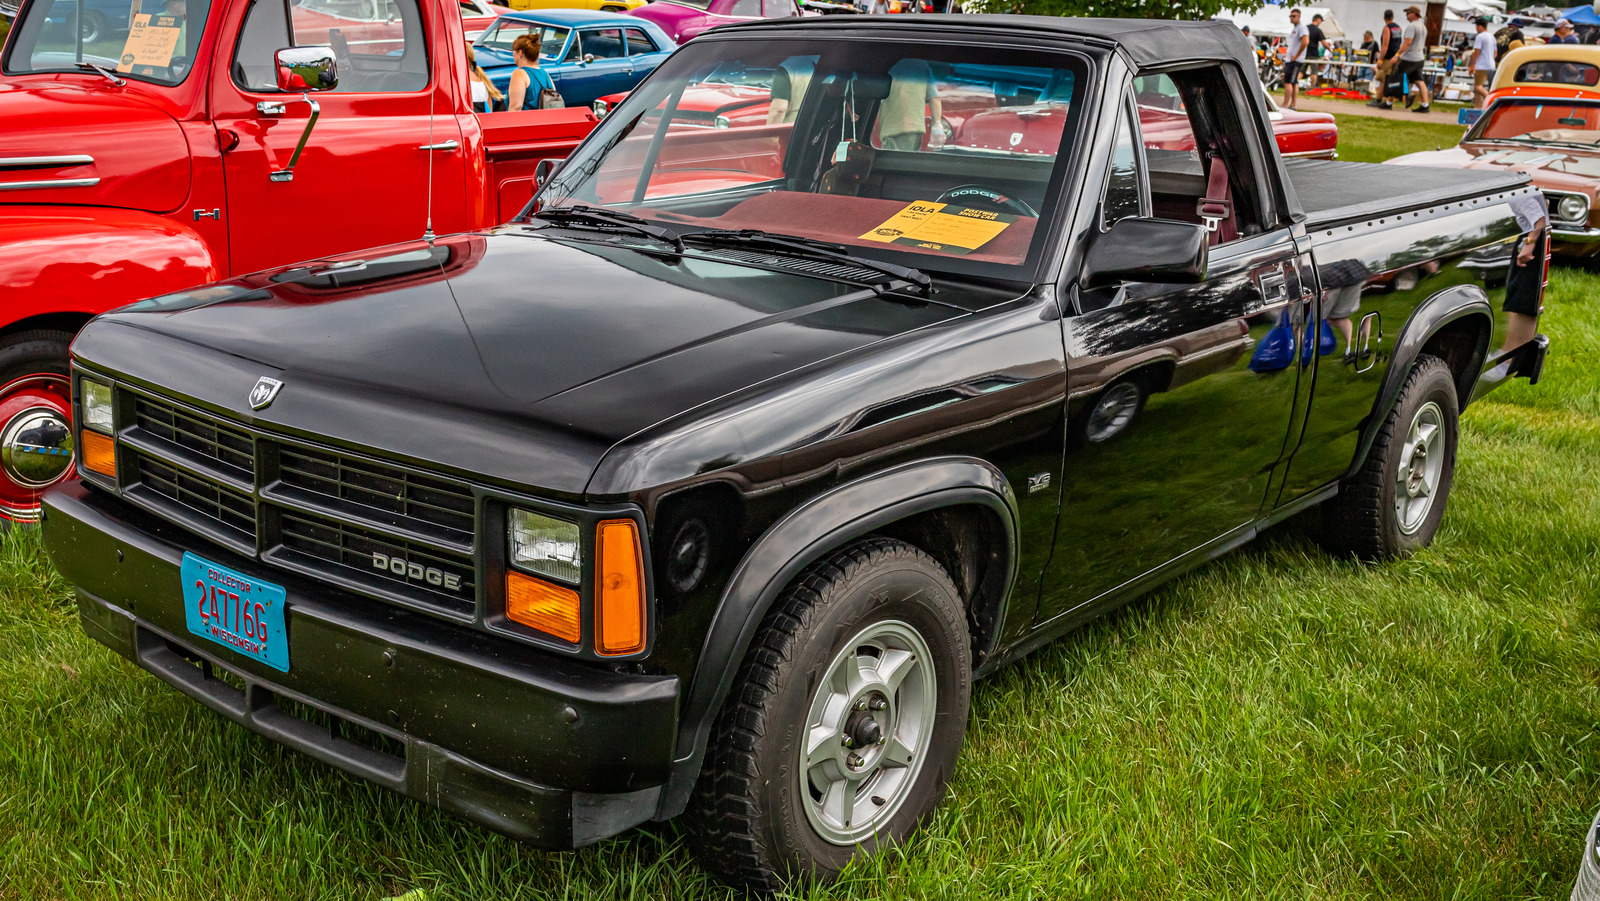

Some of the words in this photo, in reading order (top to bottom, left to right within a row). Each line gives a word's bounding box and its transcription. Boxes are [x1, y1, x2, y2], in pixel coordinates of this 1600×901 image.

[951, 189, 1000, 200] DODGE
[908, 205, 935, 214] IOLA
[207, 568, 251, 594] COLLECTOR
[373, 551, 462, 592] DODGE
[210, 624, 260, 655] WISCONSIN
